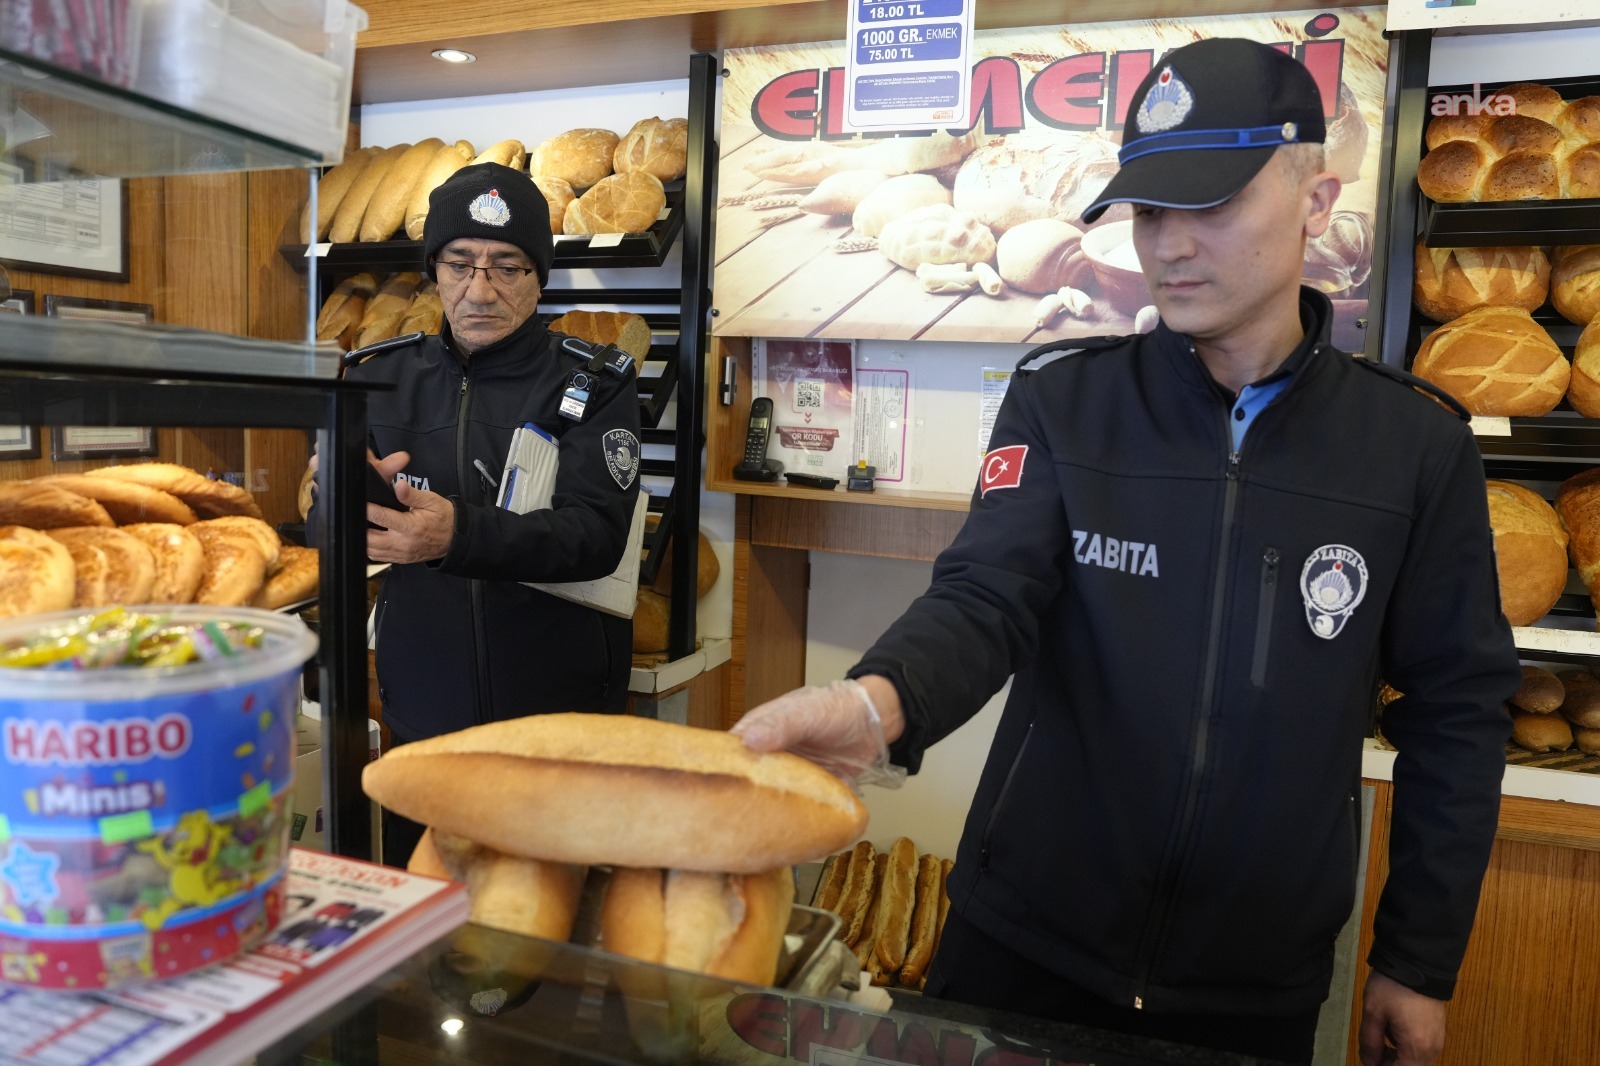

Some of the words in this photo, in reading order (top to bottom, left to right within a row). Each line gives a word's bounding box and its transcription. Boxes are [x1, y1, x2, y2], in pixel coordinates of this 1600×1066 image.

[870, 6, 904, 18] 18.00
[908, 4, 925, 16] TL
[862, 30, 895, 46] 1000
[898, 28, 923, 43] GR.
[926, 28, 958, 39] EKMEK
[869, 48, 897, 60] 75.00
[901, 48, 914, 58] TL
[609, 431, 636, 446] KARTAL
[791, 432, 802, 440] QR
[803, 433, 824, 441] KODU
[1072, 529, 1160, 578] ZABITA
[1320, 548, 1359, 567] ZABITA
[7, 716, 190, 764] HARIBO
[40, 780, 152, 817] Minis
